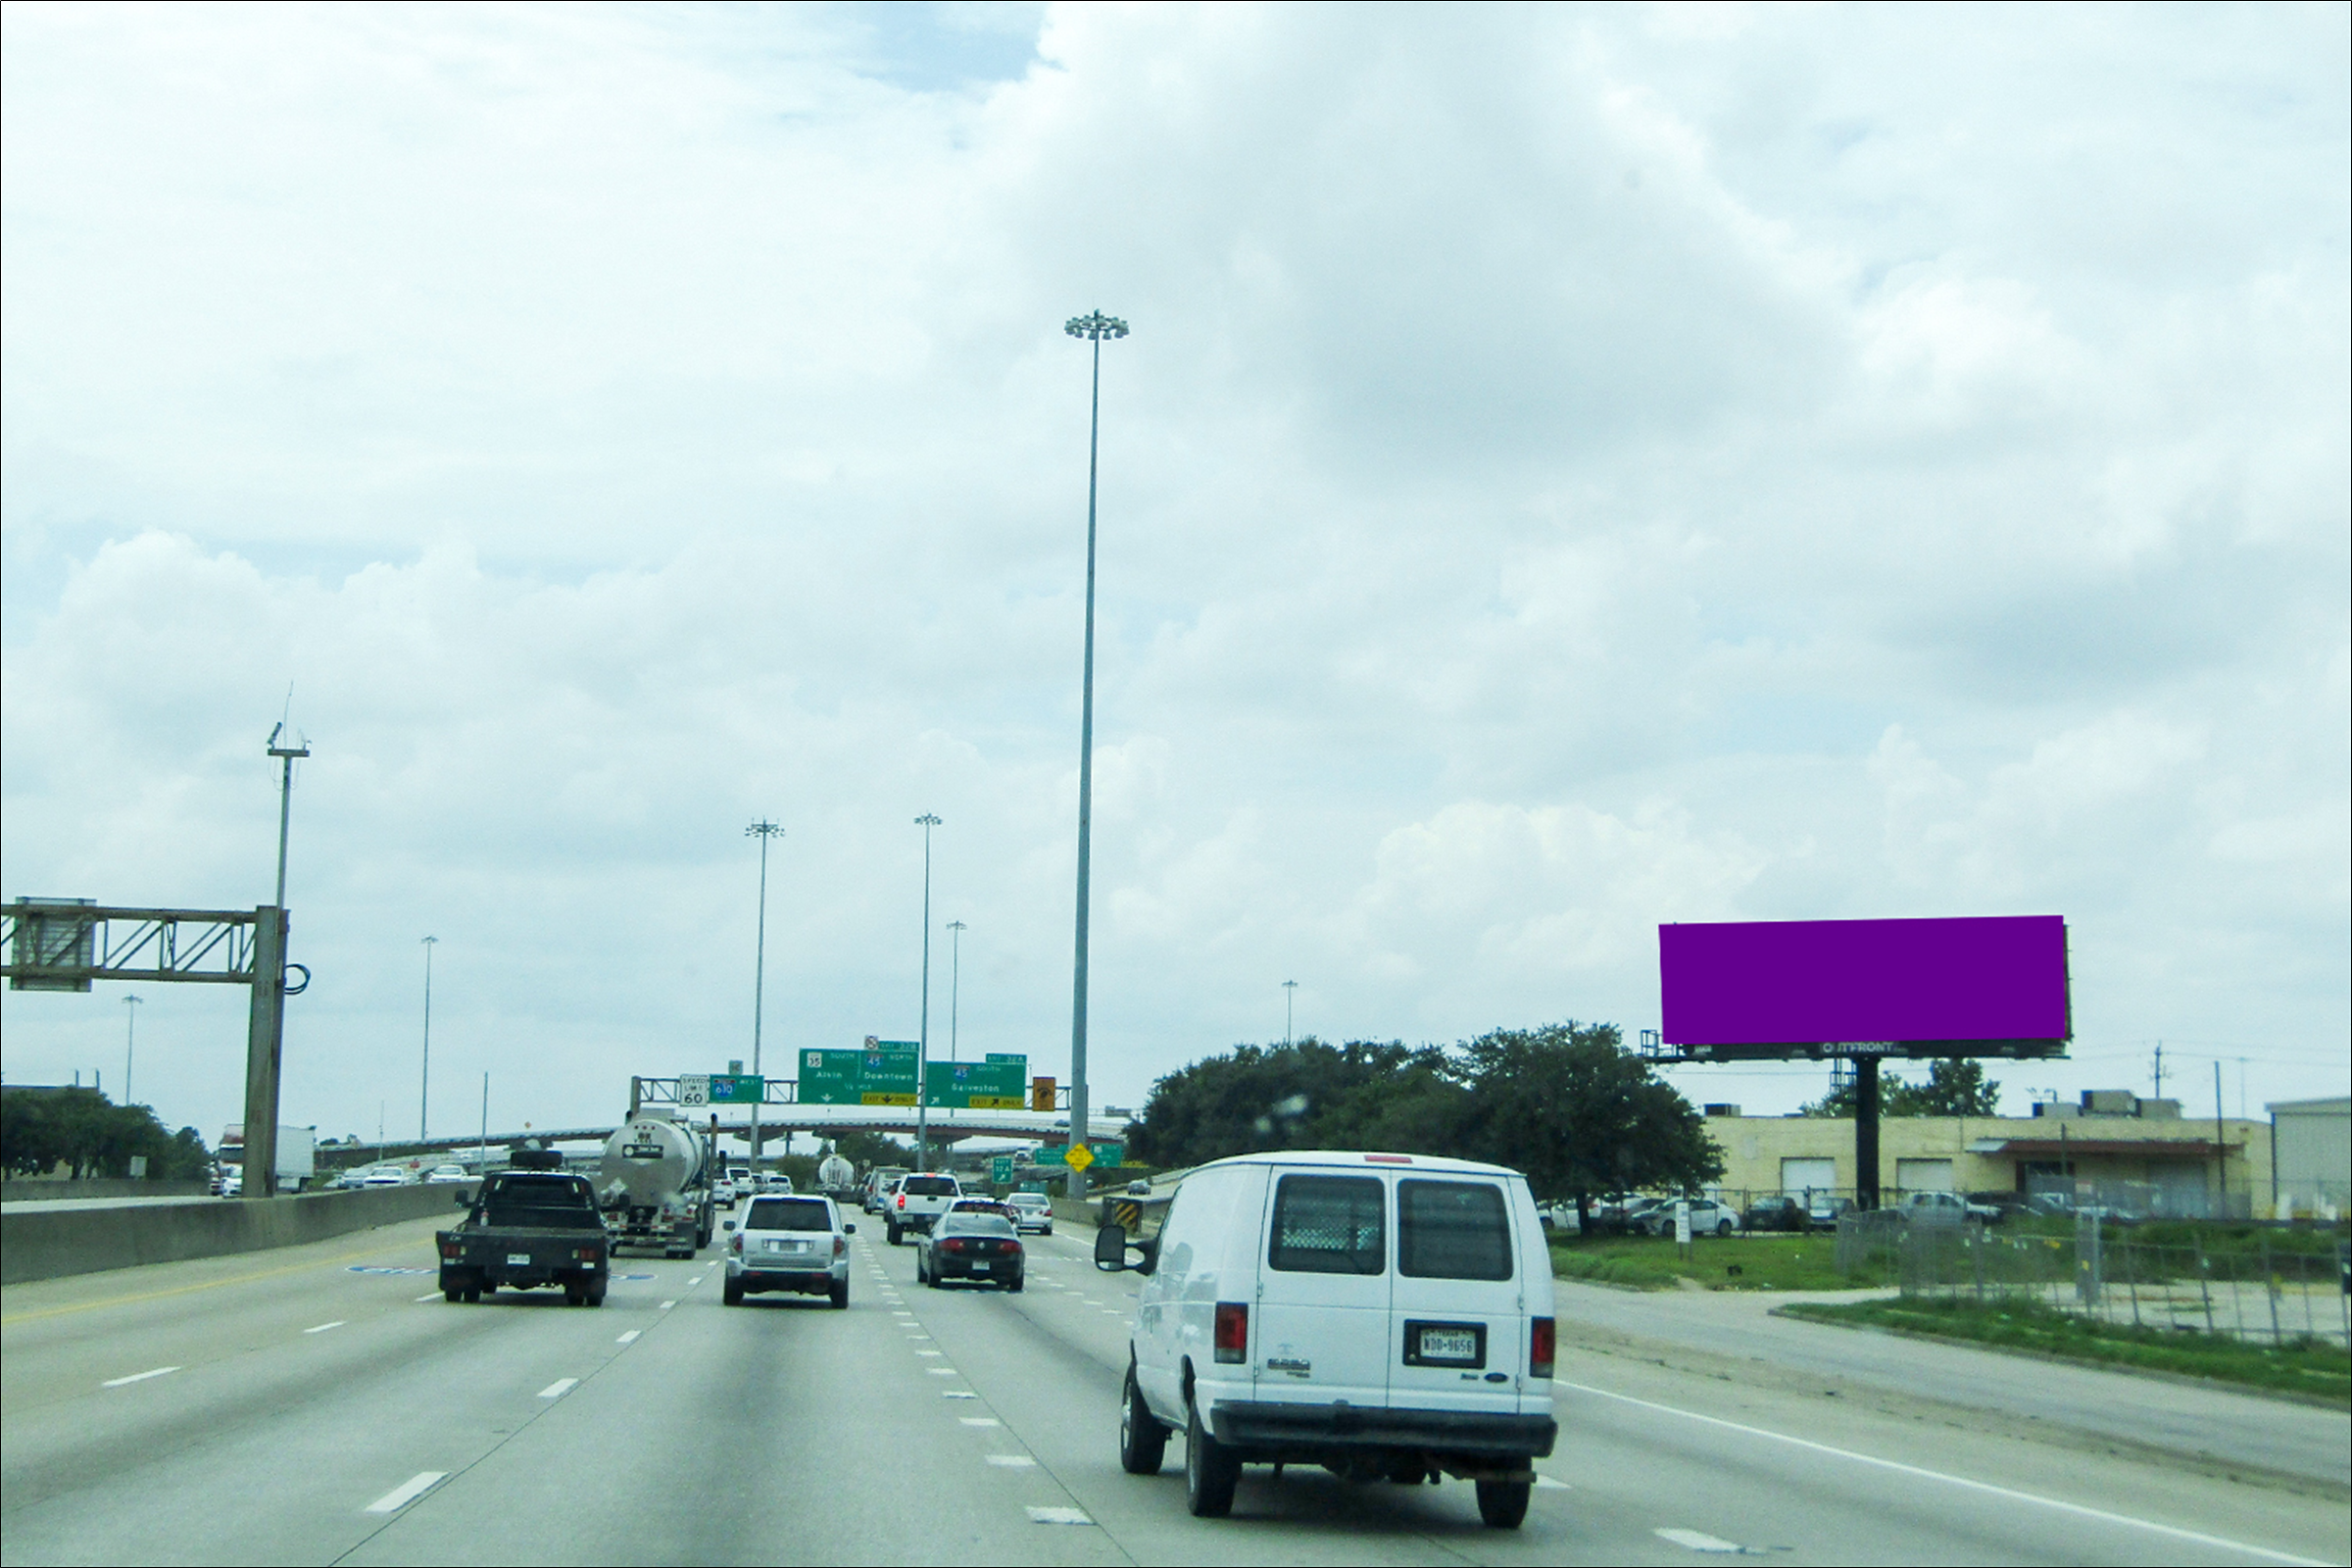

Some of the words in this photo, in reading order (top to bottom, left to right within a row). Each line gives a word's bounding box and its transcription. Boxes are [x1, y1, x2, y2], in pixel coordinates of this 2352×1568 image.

[867, 1055, 880, 1065] 45
[864, 1071, 913, 1080] Downtown
[955, 1067, 967, 1078] 45
[715, 1084, 733, 1094] 610
[951, 1082, 1000, 1093] Galveston
[684, 1094, 703, 1103] 60
